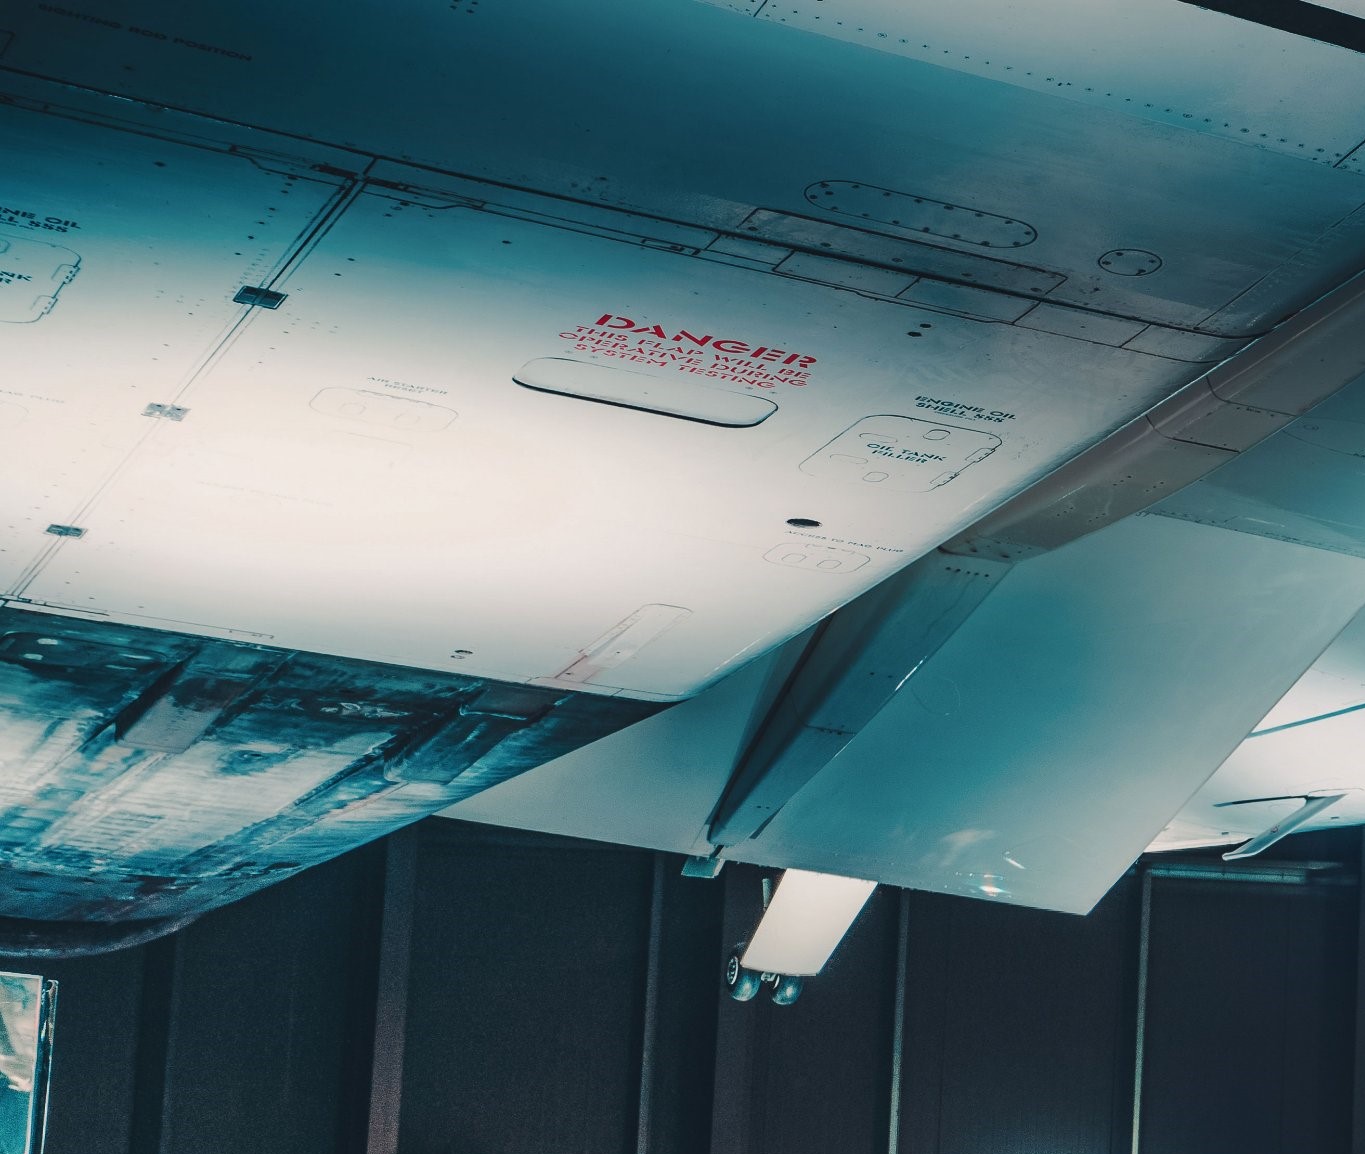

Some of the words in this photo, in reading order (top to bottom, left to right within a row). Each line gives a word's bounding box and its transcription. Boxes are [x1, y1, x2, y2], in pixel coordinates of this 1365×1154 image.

[172, 36, 253, 62] POSITION
[45, 216, 81, 230] OIL
[575, 325, 630, 342] THIS
[637, 338, 704, 356] FLAP
[714, 354, 768, 372] WILL
[778, 367, 813, 380] BE
[594, 313, 818, 370] DANGER
[558, 332, 703, 366] OPERATIVE
[710, 362, 809, 388] DURING
[574, 343, 669, 367] SYSTEM
[678, 364, 777, 390] TESTING
[914, 395, 989, 413] ENGINE
[989, 410, 1017, 421] OIL
[915, 402, 967, 418] SHELL
[866, 442, 895, 452] OIL
[900, 448, 948, 462] TANK
[871, 449, 929, 465] FILLER
